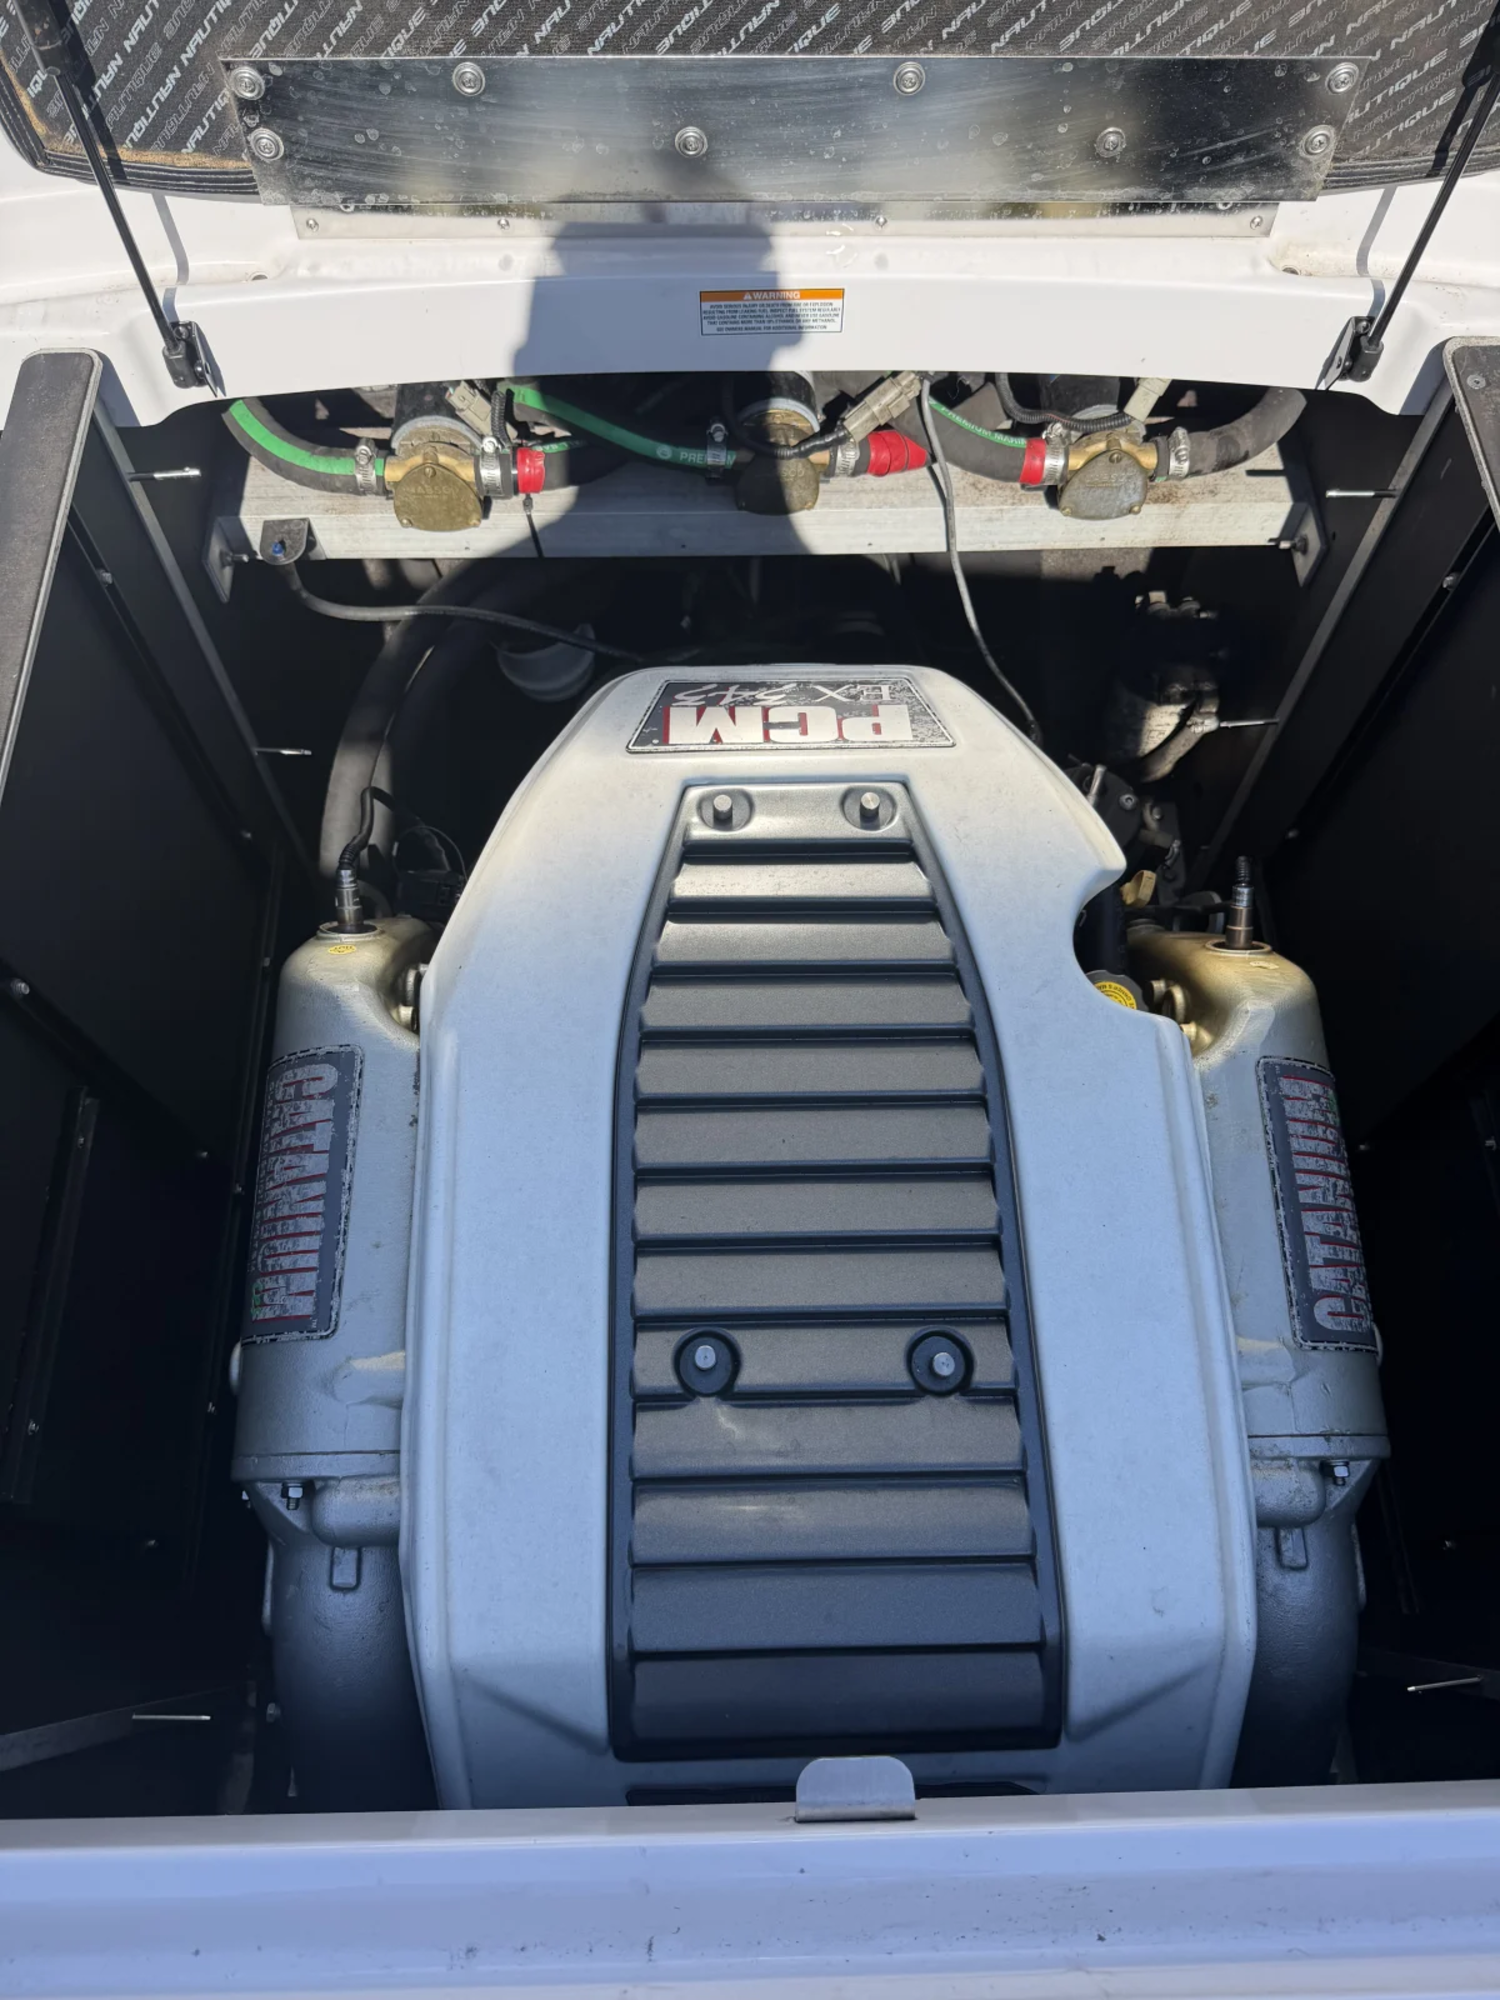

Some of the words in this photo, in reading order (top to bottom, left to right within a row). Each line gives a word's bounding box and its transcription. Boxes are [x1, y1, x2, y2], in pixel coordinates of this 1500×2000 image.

[122, 64, 182, 149] NAUTIQU
[753, 291, 800, 300] WARNING
[672, 683, 797, 707] 343
[814, 684, 893, 702] EX
[662, 704, 913, 745] PCM
[252, 1063, 338, 1322] CATANIUM
[1279, 1074, 1371, 1333] CATANIUM
